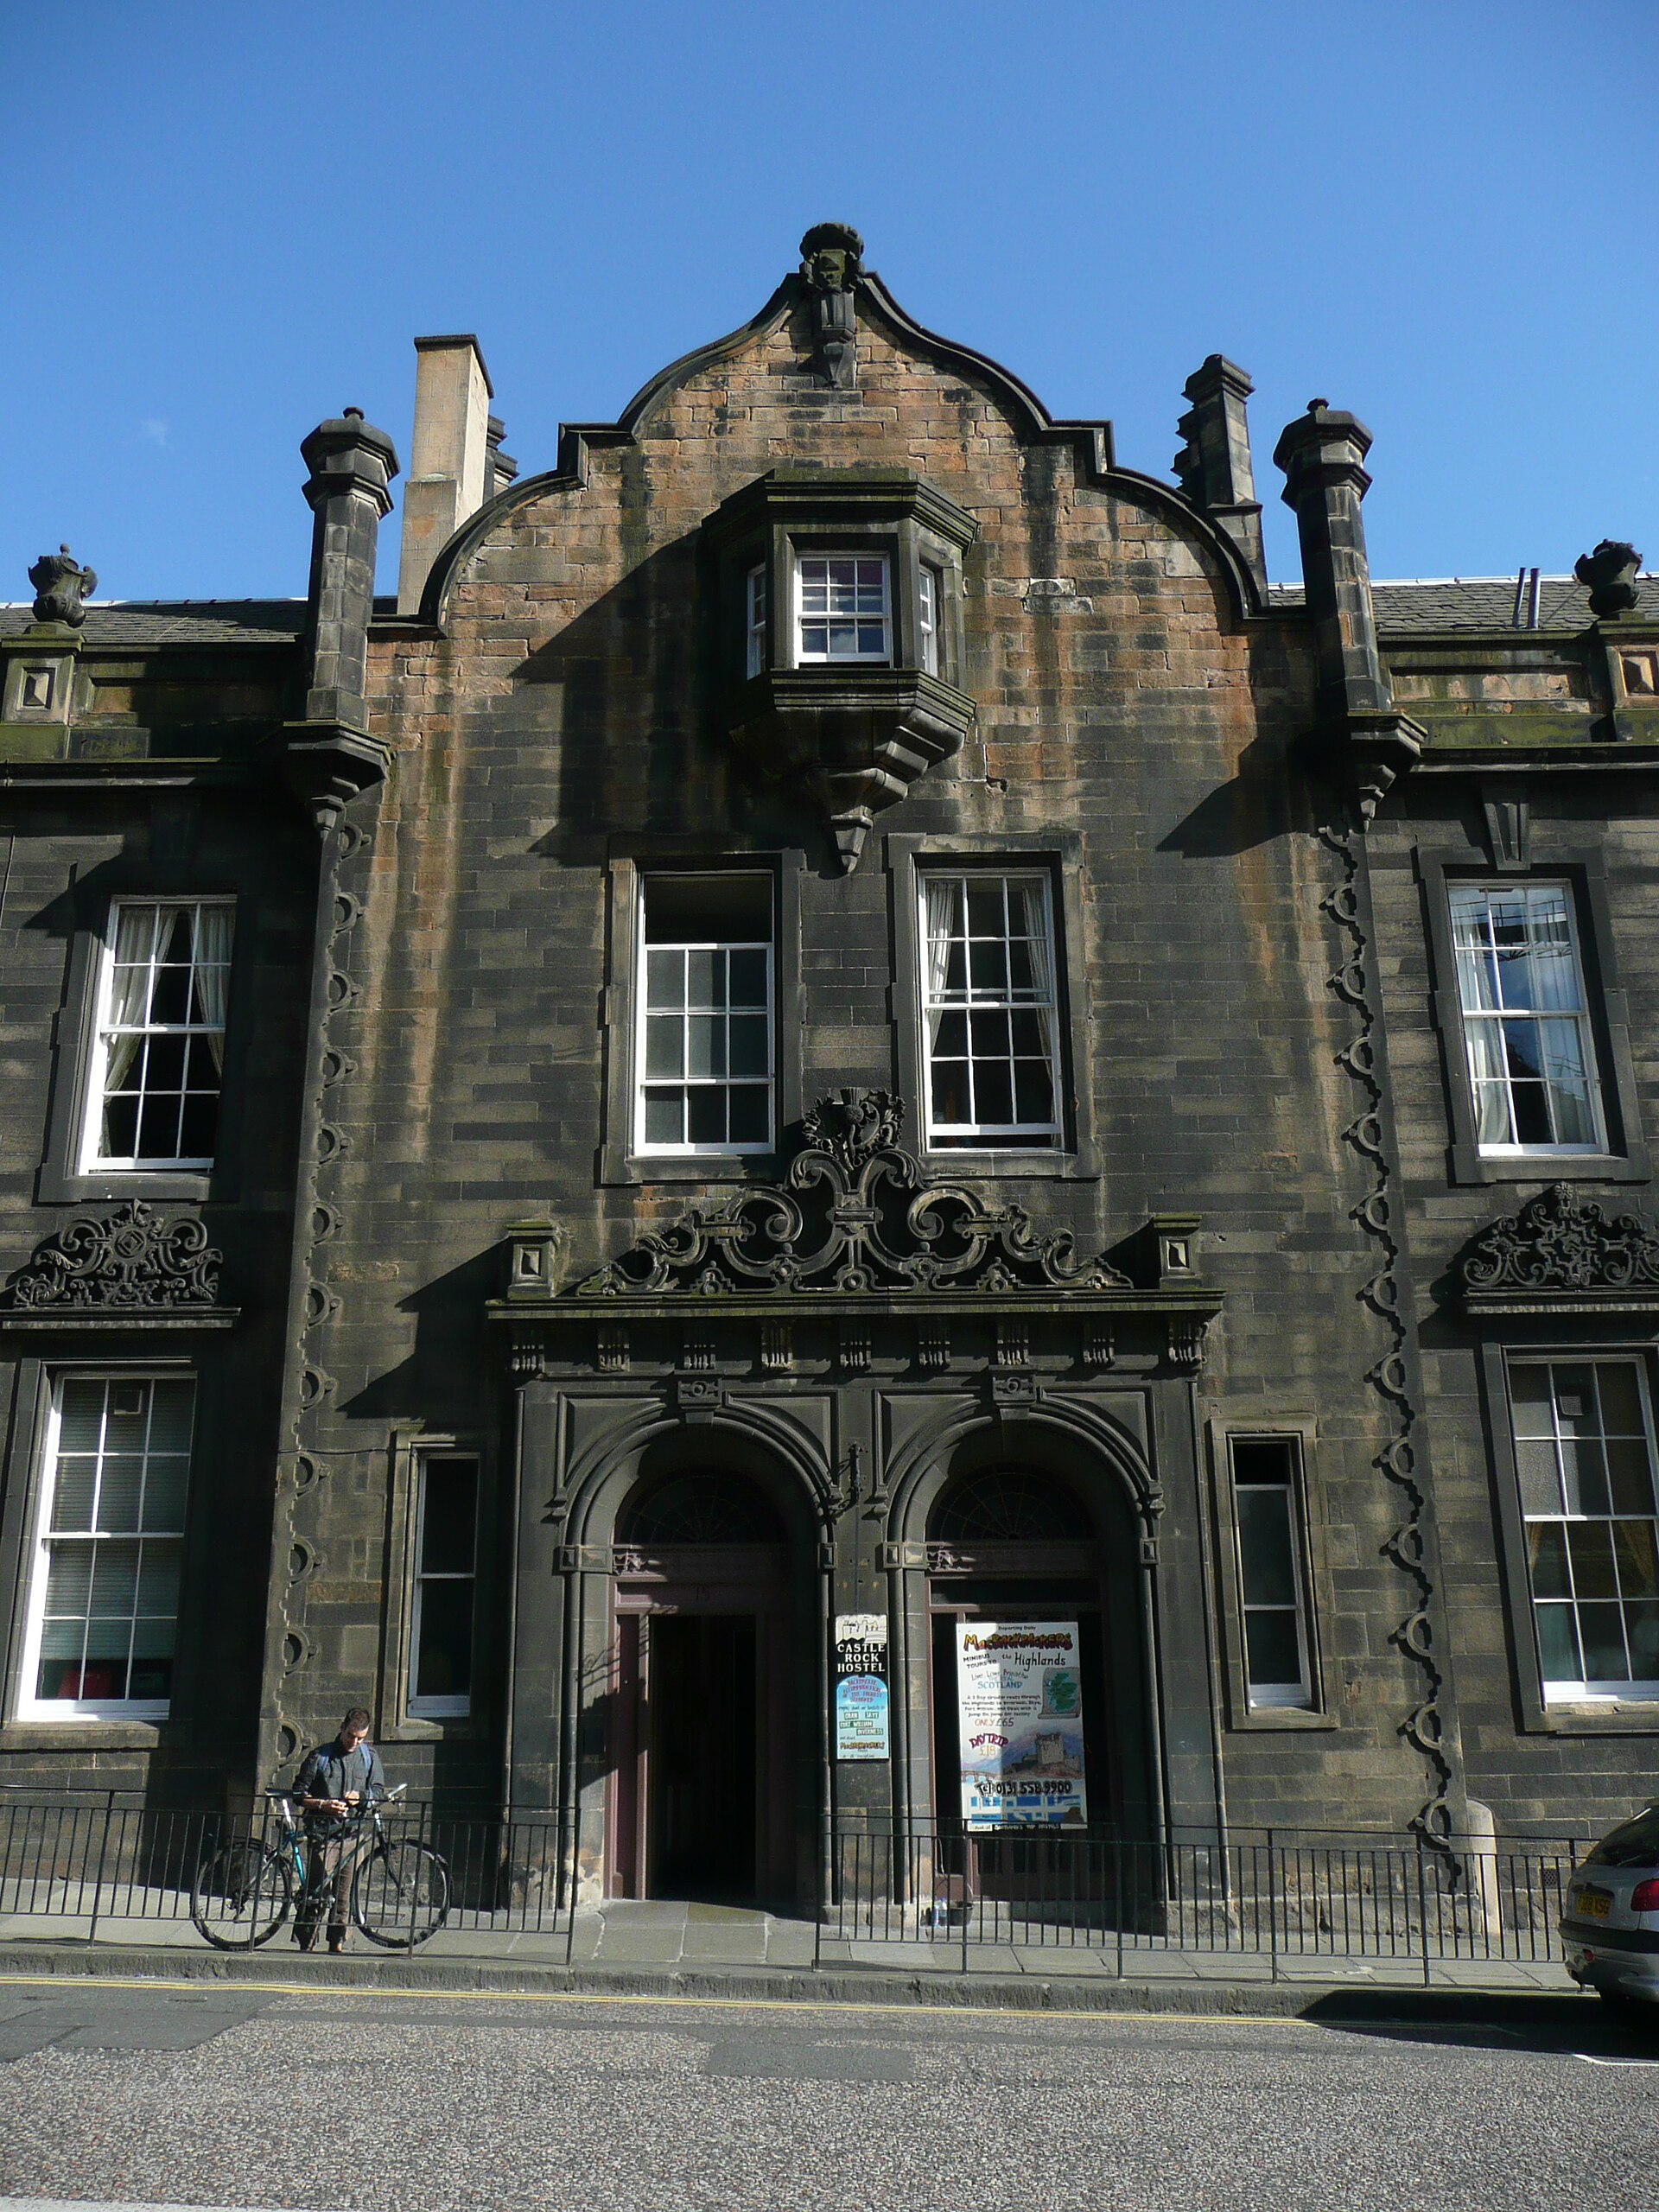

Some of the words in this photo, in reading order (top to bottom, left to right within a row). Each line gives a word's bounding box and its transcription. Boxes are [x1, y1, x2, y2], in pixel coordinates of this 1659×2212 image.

[837, 1643, 886, 1653] CASTLE
[845, 1653, 879, 1662] ROCK
[963, 1653, 990, 1662] MINIBUS
[1014, 1651, 1066, 1672] Highlands
[837, 1662, 886, 1673] HOSTEL
[977, 1681, 1023, 1689] SCOTLAND
[995, 1718, 1014, 1727] £65
[979, 1745, 996, 1757] £18
[996, 1781, 1017, 1796] 0131
[1020, 1780, 1042, 1796] 558
[1044, 1780, 1072, 1796] 9900
